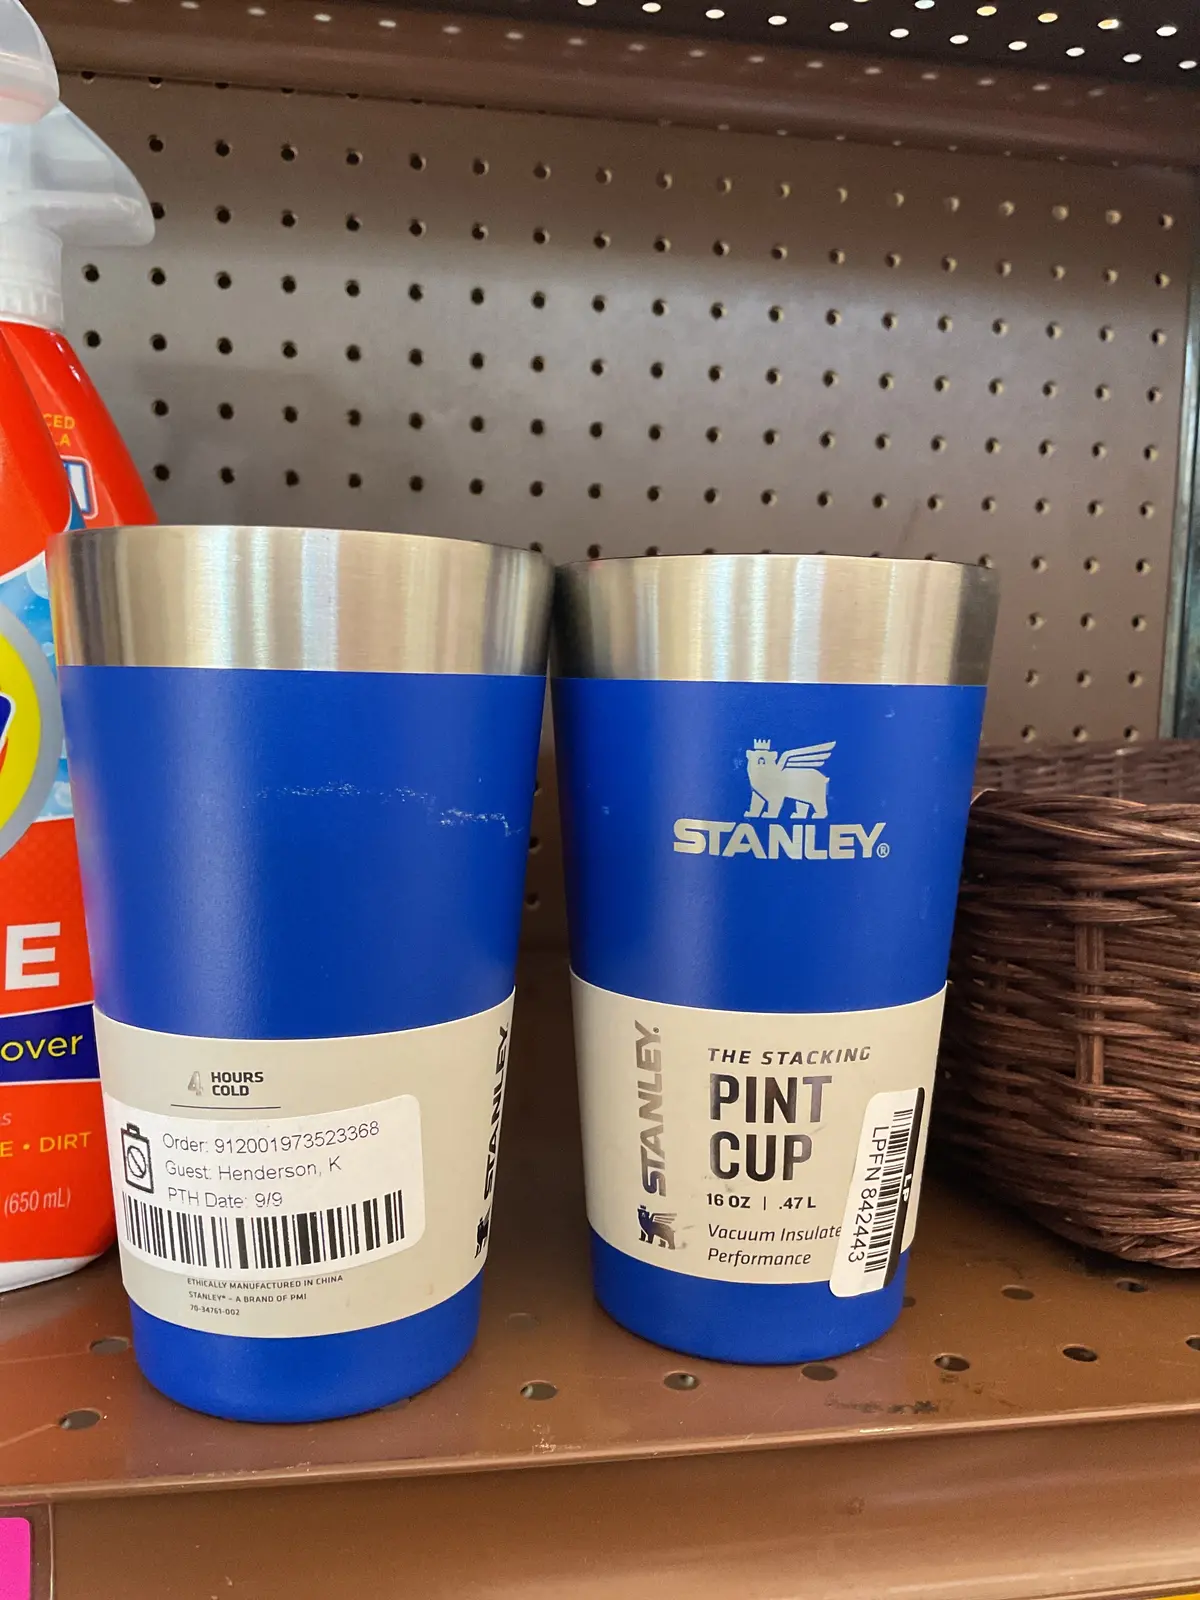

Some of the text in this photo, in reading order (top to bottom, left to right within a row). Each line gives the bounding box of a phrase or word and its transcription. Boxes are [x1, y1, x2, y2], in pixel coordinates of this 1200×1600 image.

[1, 1033, 84, 1063] over
[707, 1046, 871, 1066] THE STACKING
[187, 1070, 204, 1096] 4
[211, 1071, 264, 1083] HOURS
[212, 1085, 250, 1096] COLD
[709, 1073, 833, 1124] PINT
[40, 1131, 92, 1153] DIRT
[162, 1120, 380, 1153] Order: 912001973523368
[709, 1131, 813, 1182] CUP
[165, 1156, 342, 1181] Guest: Henderson, K
[168, 1186, 283, 1208] PTH Date: 9/9
[848, 1126, 889, 1263] LPFN 842443
[903, 1174, 912, 1201] LP
[4, 1186, 71, 1219] (650 mL)
[707, 1193, 724, 1206] 16
[728, 1195, 751, 1209] OZ
[779, 1197, 803, 1209] .47
[807, 1196, 816, 1209] L
[708, 1223, 775, 1241] Vacuum
[708, 1247, 811, 1267] Performance
[187, 1275, 343, 1290] ETHICALLY MANUFACTURED IN CHINA
[243, 1295, 274, 1303] BRAND
[276, 1294, 288, 1302] OF
[290, 1293, 307, 1301] PMI
[190, 1304, 240, 1316] 70-34761-002
